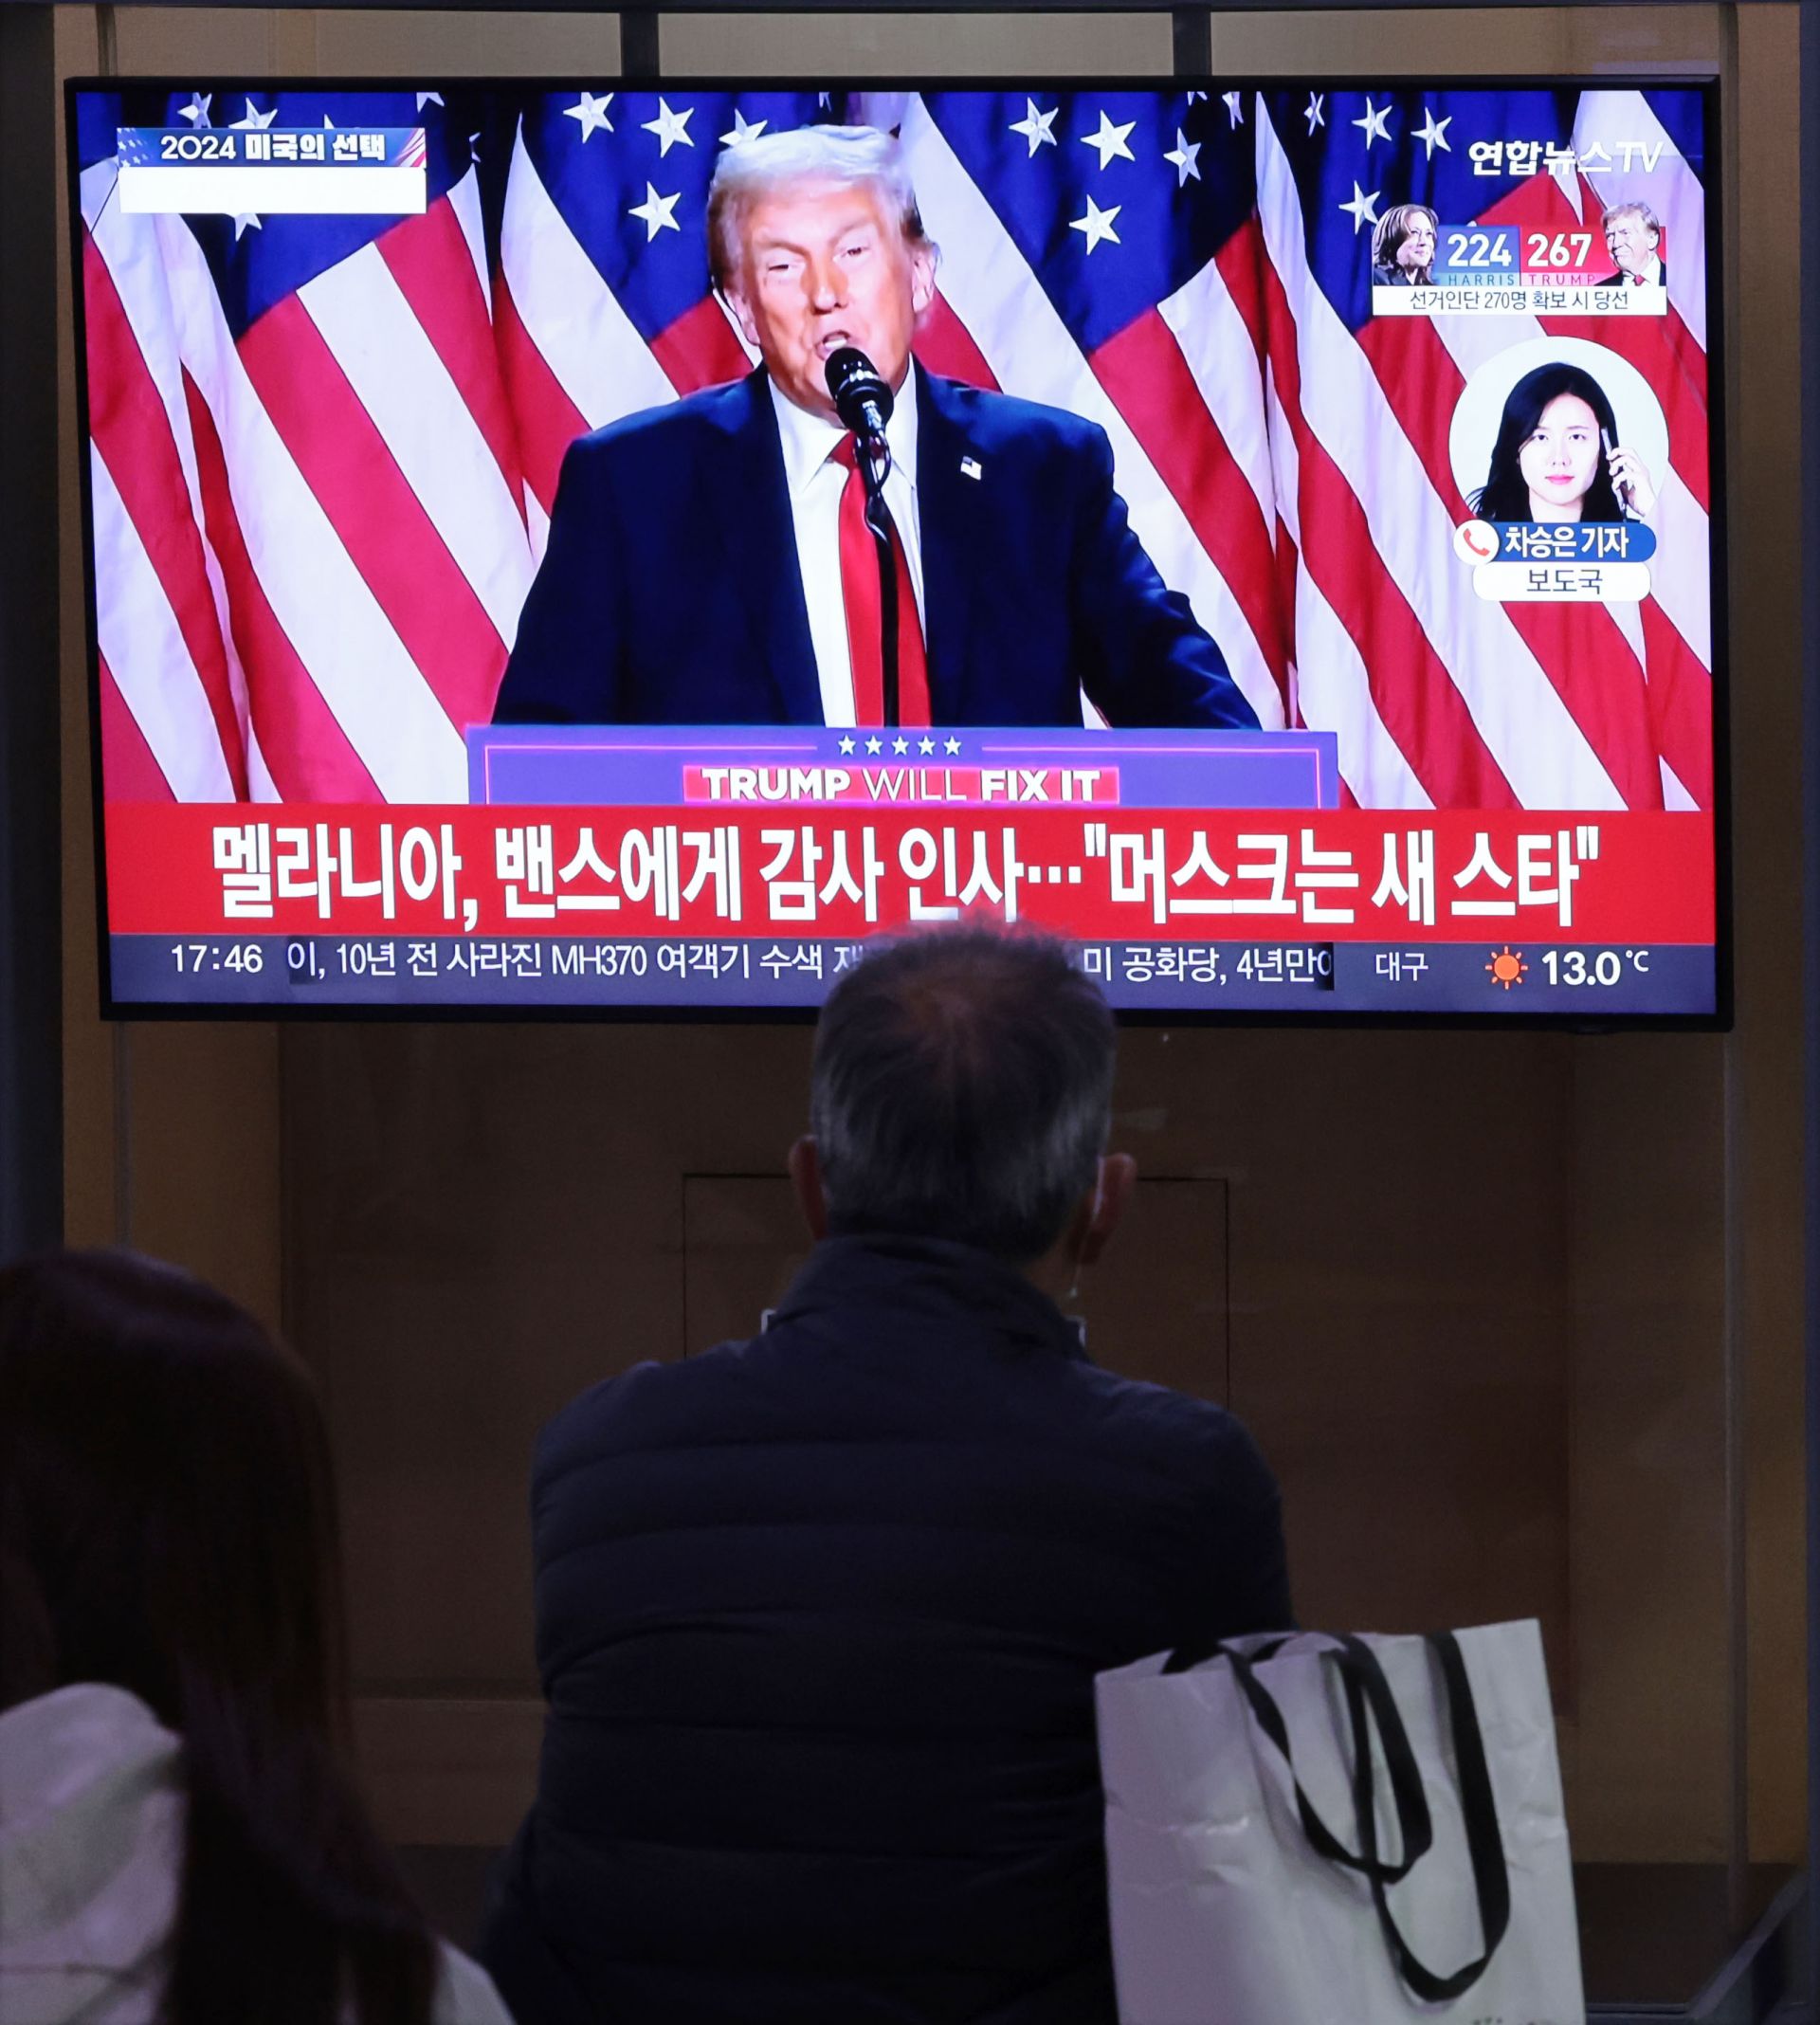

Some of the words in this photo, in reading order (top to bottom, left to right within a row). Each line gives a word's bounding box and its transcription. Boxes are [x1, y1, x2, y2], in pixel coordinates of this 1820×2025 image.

[160, 135, 236, 160] 2024
[245, 134, 325, 161] 미국의
[332, 134, 386, 161] 선택
[1469, 140, 1664, 176] 연합뉴스TV
[1447, 233, 1512, 267] 224
[1527, 233, 1592, 267] 267
[1448, 274, 1515, 286] HARRIS
[1529, 274, 1596, 286] TRUMP
[1410, 291, 1479, 310] 선거인단
[1484, 291, 1527, 311] 270명
[1532, 290, 1566, 310] 확보
[1573, 291, 1590, 310] 시
[1593, 290, 1629, 311] 당선
[1505, 526, 1576, 557] 차승은
[1581, 526, 1629, 557] 기자
[1526, 569, 1603, 594] 보도국
[701, 768, 850, 800] TRUMP
[862, 768, 967, 801] WILL
[980, 769, 1049, 801] FIX
[1060, 769, 1101, 801] IT
[212, 823, 478, 933] 멜라니아,
[495, 824, 741, 921] 밴스에게
[759, 826, 884, 922] 감사
[1371, 830, 1435, 925] 새
[1451, 826, 1599, 926] 스타"
[171, 944, 263, 973] 17:46
[287, 941, 326, 979] 이,
[337, 941, 395, 976] 10년
[406, 942, 438, 976] 전
[446, 941, 542, 977] 사라진
[552, 944, 647, 976] MH370
[657, 943, 750, 978] 여객기
[759, 944, 822, 979] 수색
[1083, 946, 1112, 981] 미
[1122, 946, 1227, 985] 공화당,
[1375, 952, 1429, 981] 대구
